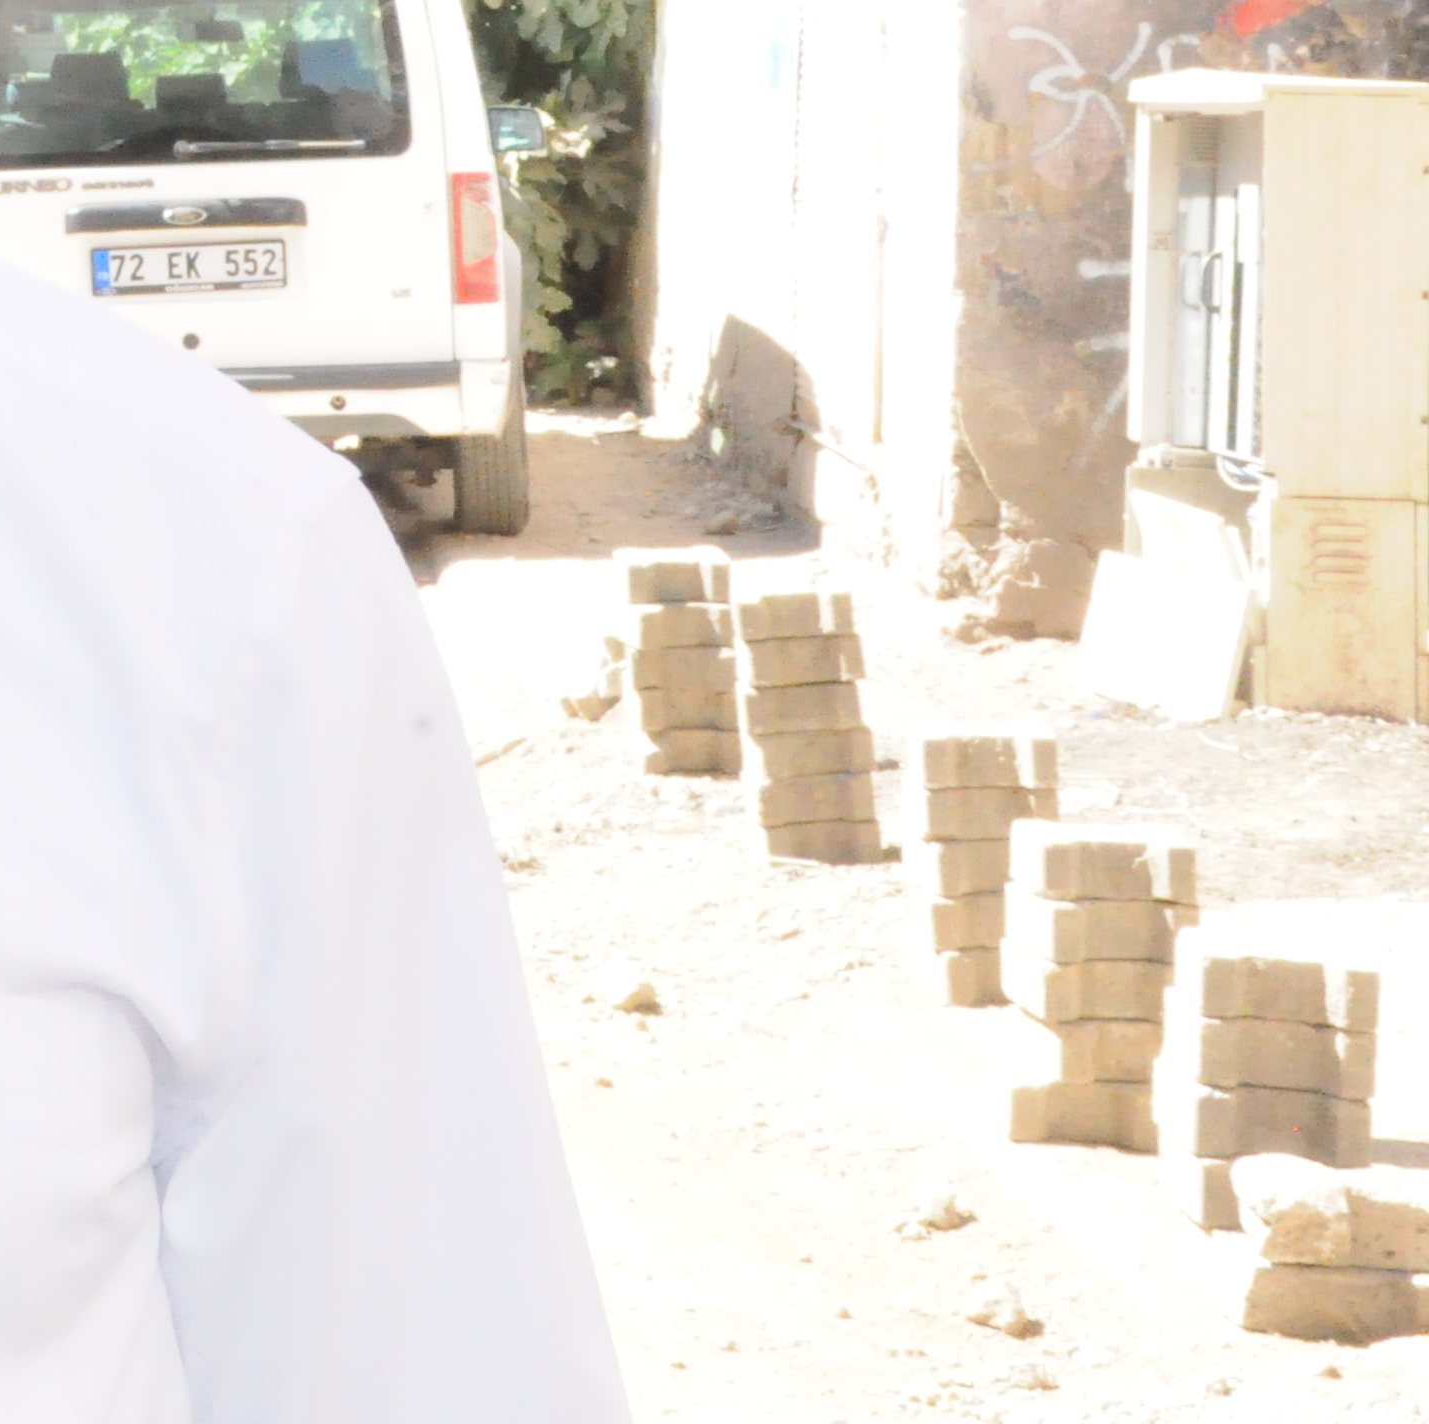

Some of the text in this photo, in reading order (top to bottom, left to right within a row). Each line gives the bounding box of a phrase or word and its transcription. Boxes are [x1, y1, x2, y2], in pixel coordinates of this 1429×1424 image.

[110, 249, 278, 283] 72 EK 552
